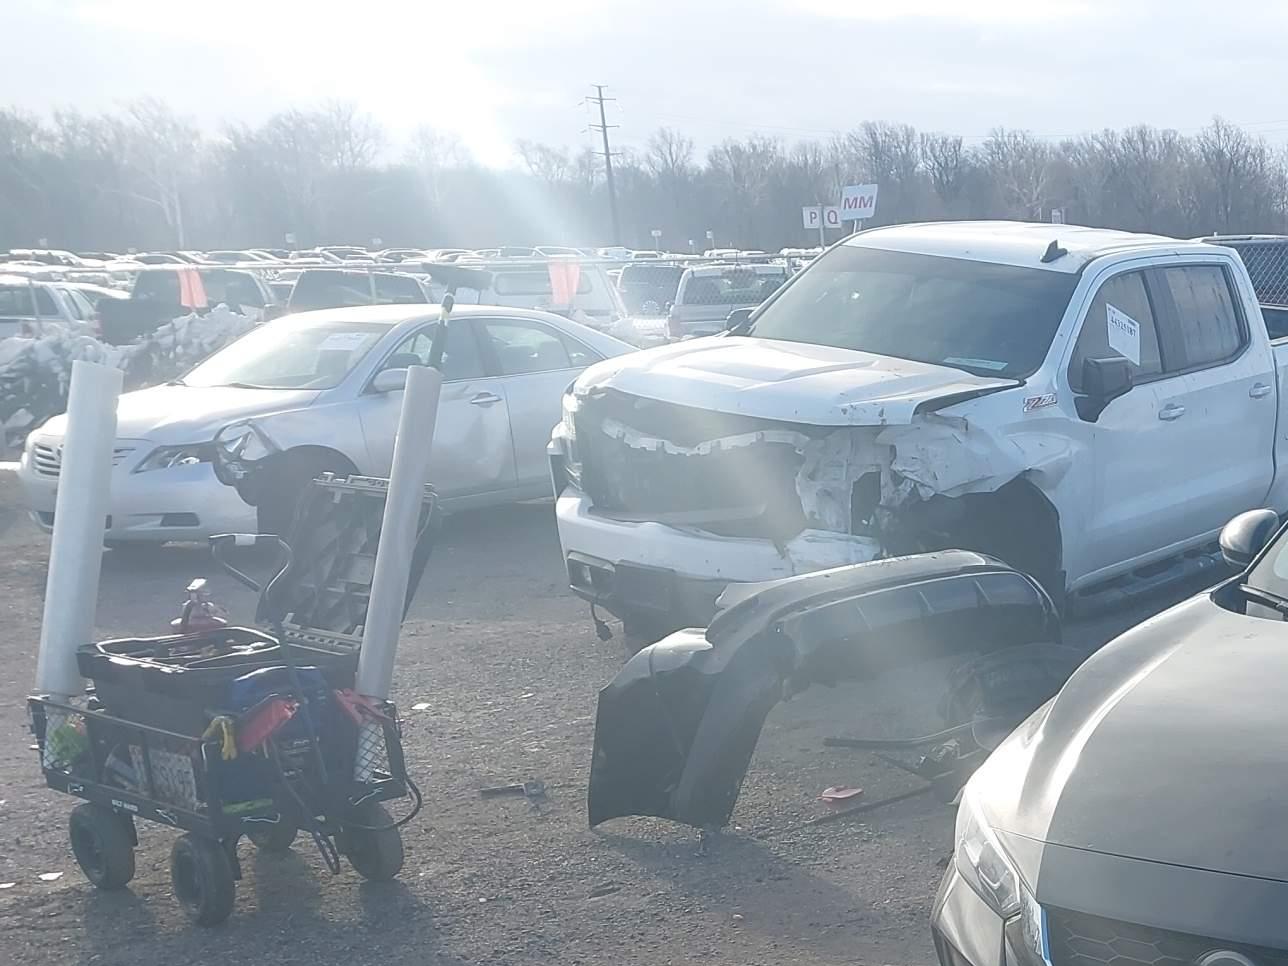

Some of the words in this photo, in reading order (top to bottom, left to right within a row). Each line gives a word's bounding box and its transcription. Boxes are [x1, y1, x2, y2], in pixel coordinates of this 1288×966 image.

[843, 195, 873, 209] MM
[809, 211, 817, 224] P
[827, 209, 838, 224] Q
